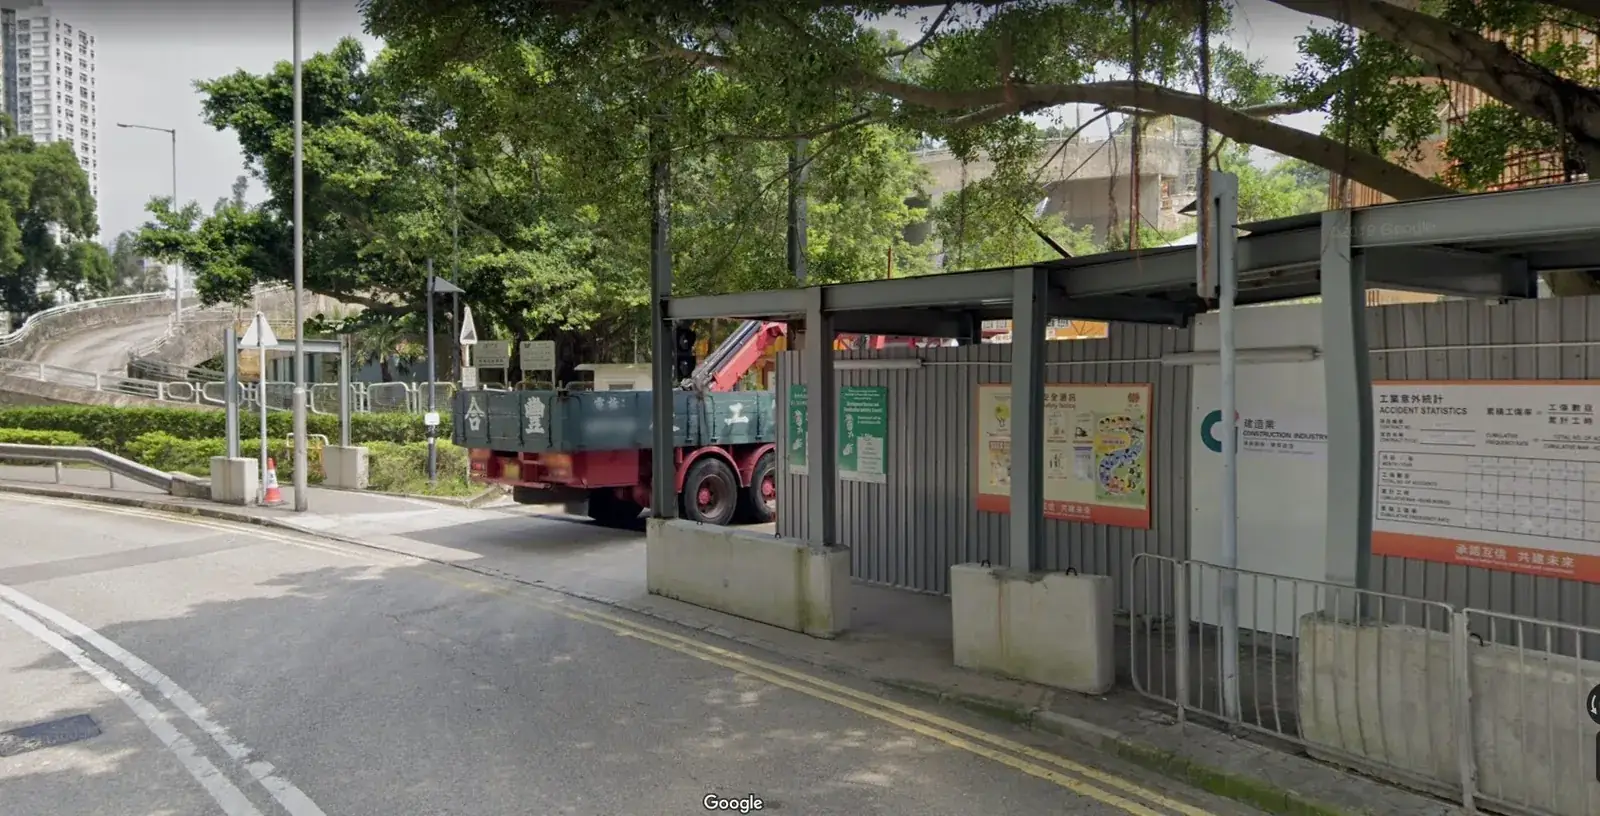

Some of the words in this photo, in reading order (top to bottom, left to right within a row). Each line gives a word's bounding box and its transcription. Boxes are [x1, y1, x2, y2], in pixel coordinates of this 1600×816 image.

[464, 396, 485, 431] 合
[1380, 406, 1419, 414] ACCIDENT
[1420, 406, 1468, 415] STATISTICS
[1243, 430, 1292, 439] CONSTRUCTION
[1293, 432, 1328, 440] INDUSTRY
